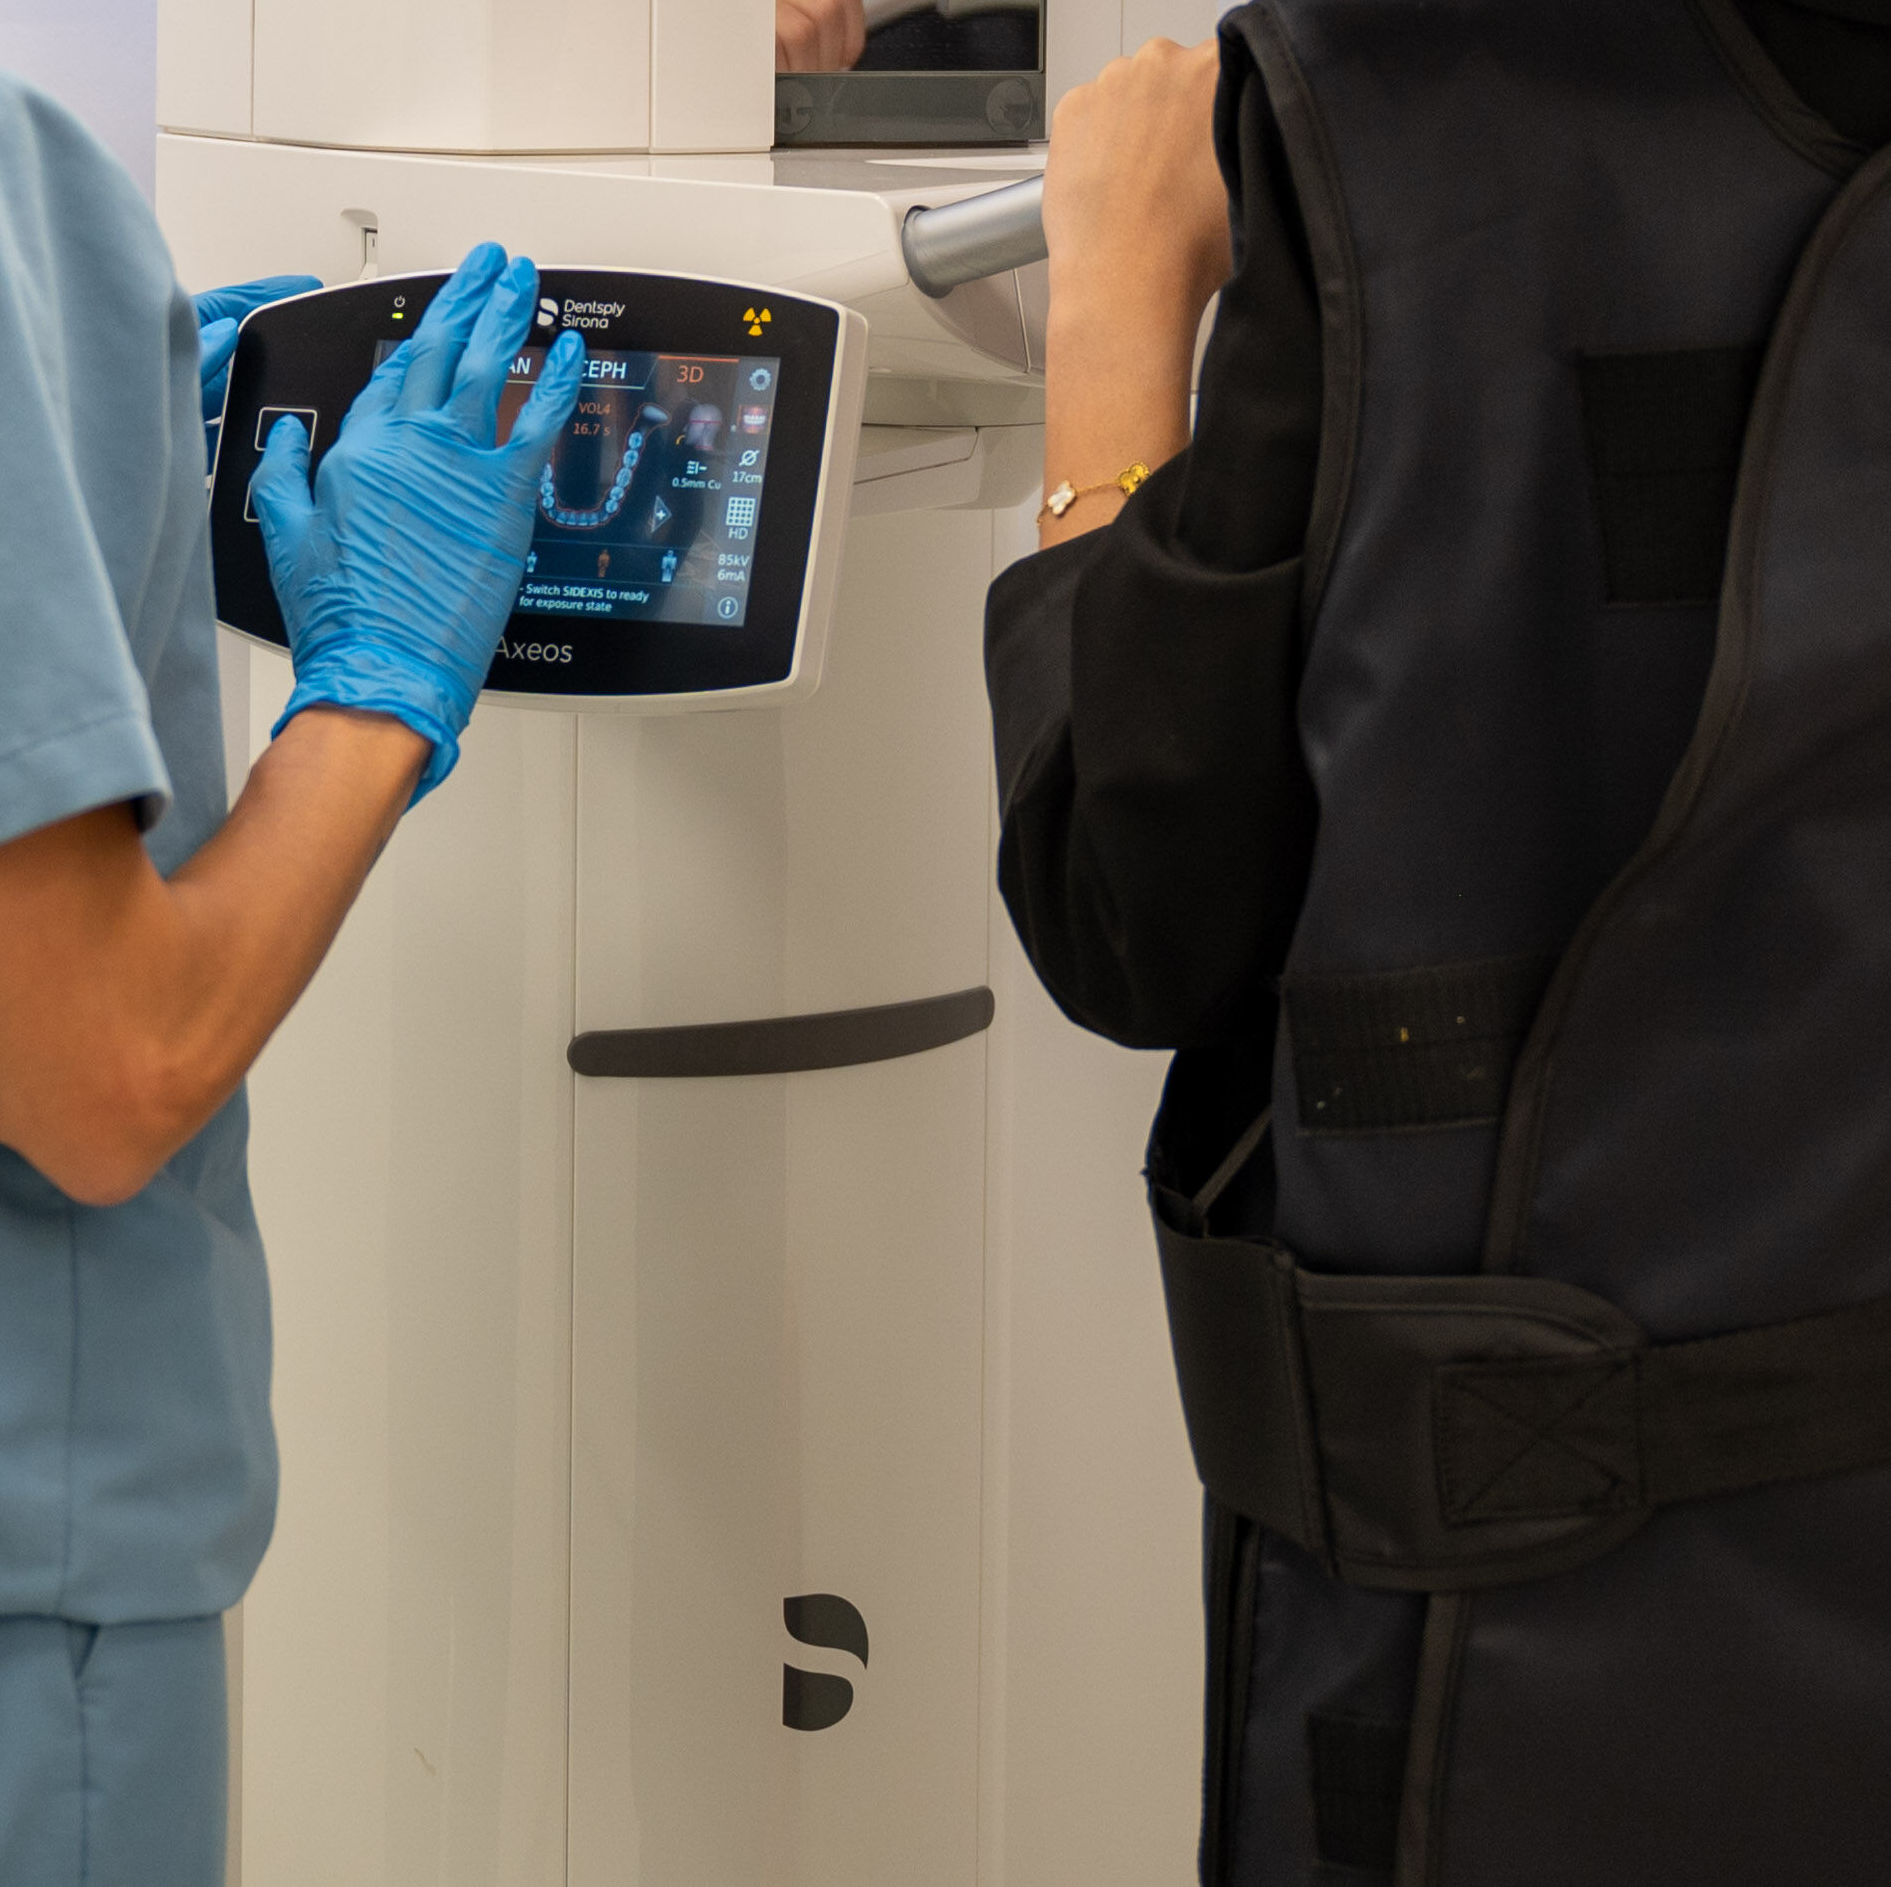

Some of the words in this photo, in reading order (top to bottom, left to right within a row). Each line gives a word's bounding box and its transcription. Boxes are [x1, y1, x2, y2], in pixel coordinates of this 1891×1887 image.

[563, 298, 626, 318] Dentsply
[561, 314, 610, 329] Sirona
[676, 365, 705, 384] 3D
[573, 422, 600, 435] 16.7
[672, 477, 706, 490] 0.5mm
[707, 479, 722, 490] Cu
[732, 471, 763, 484] 17cm
[728, 527, 748, 540] HD
[717, 553, 750, 567] 85kV
[717, 568, 746, 581] 6mA
[526, 583, 561, 596] Switch
[562, 585, 604, 599] SIDEXIS
[606, 588, 617, 600] to
[618, 590, 650, 604] ready
[519, 595, 535, 607] for
[535, 598, 584, 611] exposure
[585, 601, 613, 613] state
[495, 635, 574, 663] Axeos
